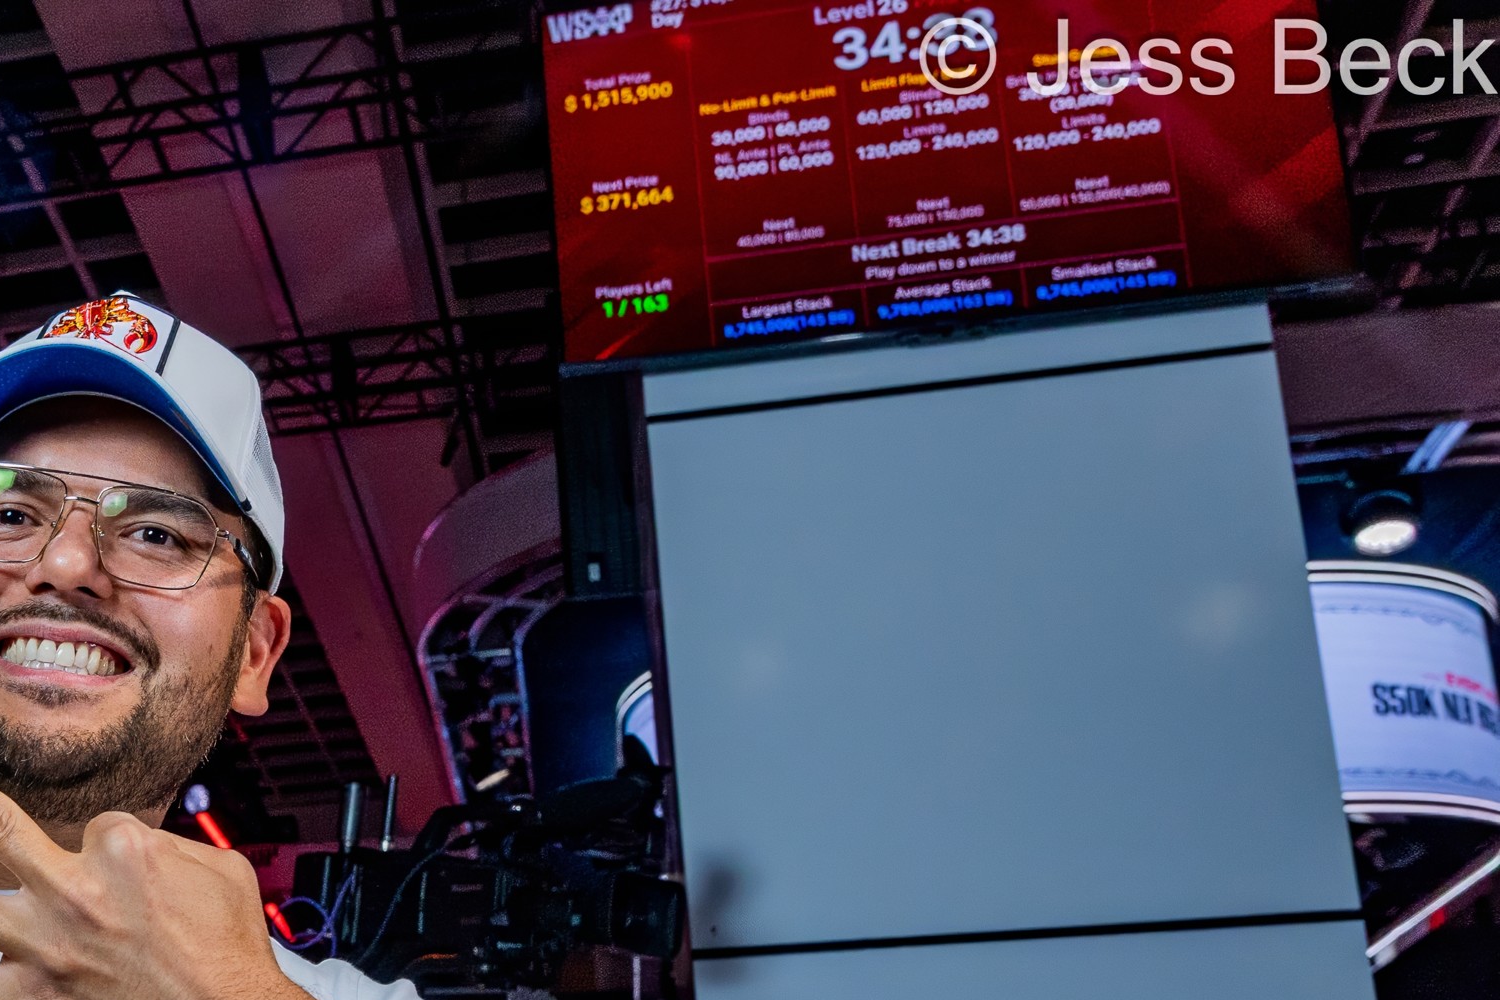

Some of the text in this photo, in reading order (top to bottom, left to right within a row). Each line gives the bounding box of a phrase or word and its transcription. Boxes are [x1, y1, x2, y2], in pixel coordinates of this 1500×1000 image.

[651, 12, 684, 28] Day
[813, 0, 909, 25] Level 26
[584, 72, 651, 91] Total Prize
[582, 81, 673, 111] 1,515,900
[856, 104, 913, 125] 60,000
[923, 93, 989, 115] 120,000
[711, 125, 766, 147] 30,000
[775, 116, 831, 137] 60,000
[856, 138, 922, 160] 120,000
[932, 127, 999, 150] 240,000
[1013, 129, 1081, 151] 120,000
[1091, 117, 1162, 142] 240,000
[592, 175, 659, 193] Next Prize
[596, 185, 674, 211] 371,664
[851, 223, 1027, 262] Next Break 34:38
[865, 250, 1017, 280] Play down to a winner
[1051, 255, 1157, 281] Smallest Stack
[595, 277, 672, 300] Players Left
[894, 275, 992, 300] Average Stack
[632, 293, 669, 314] 163
[742, 295, 833, 319] Largest Stack
